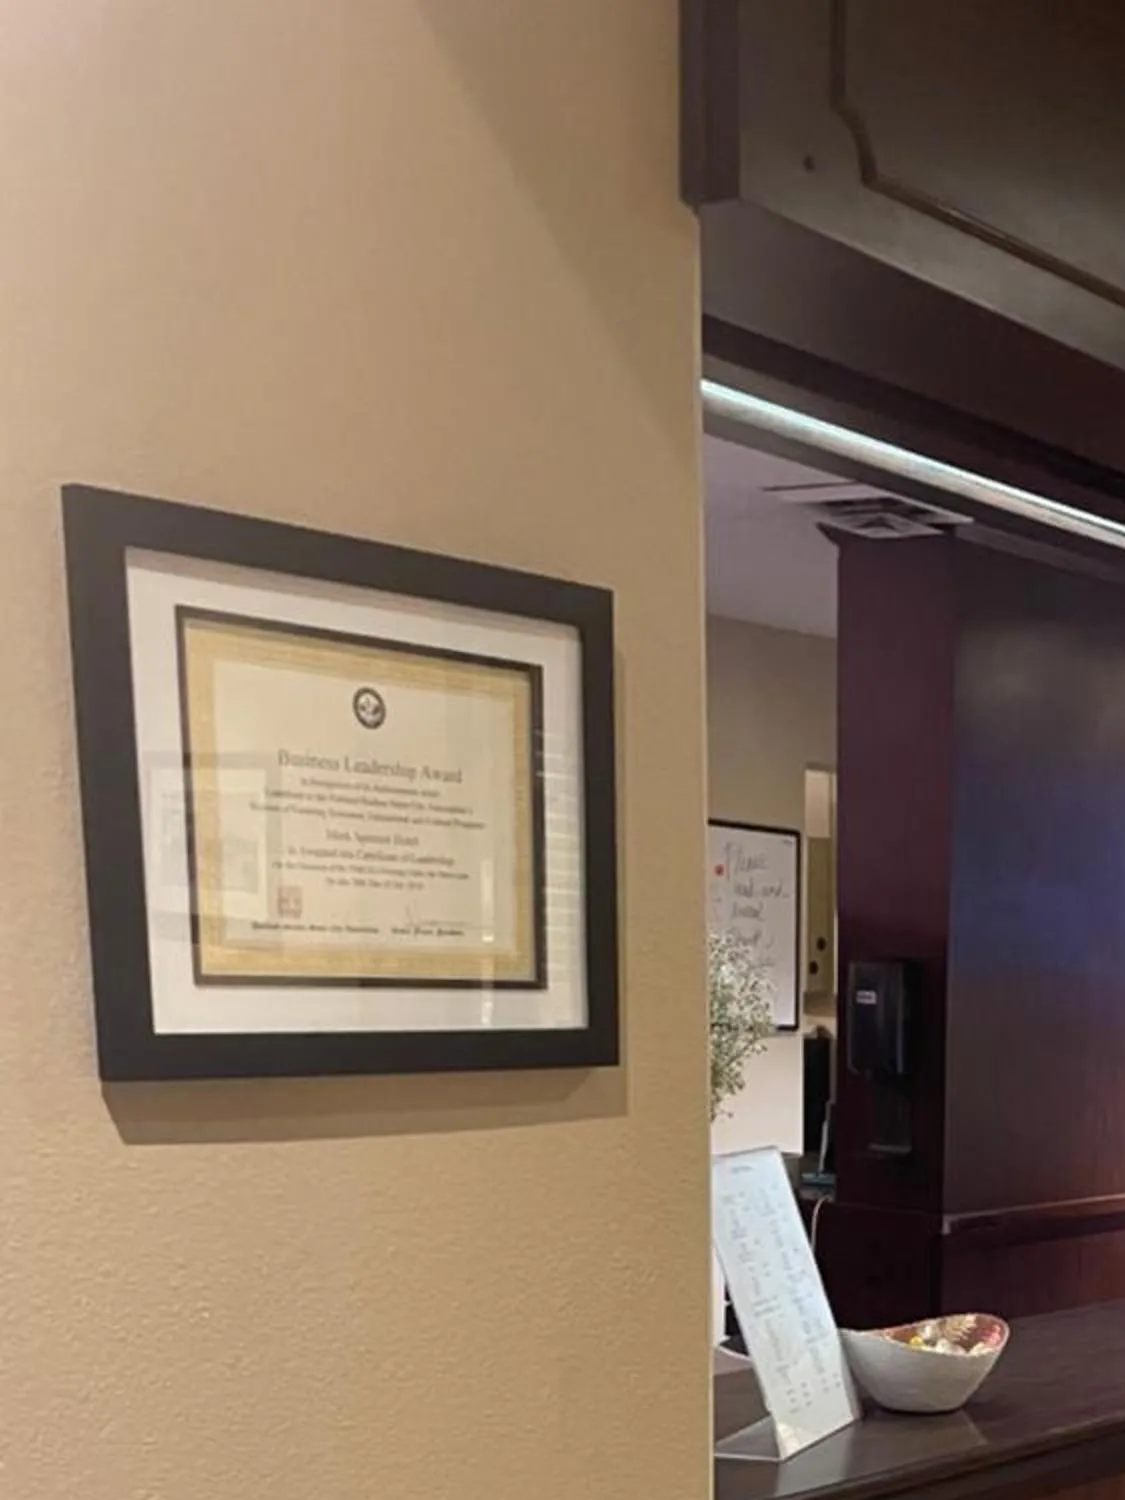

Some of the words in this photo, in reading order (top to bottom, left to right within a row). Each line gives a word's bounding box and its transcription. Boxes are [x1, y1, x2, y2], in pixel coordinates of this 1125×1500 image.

[277, 749, 340, 771] Business
[343, 754, 416, 783] Leadership
[421, 764, 462, 785] Award
